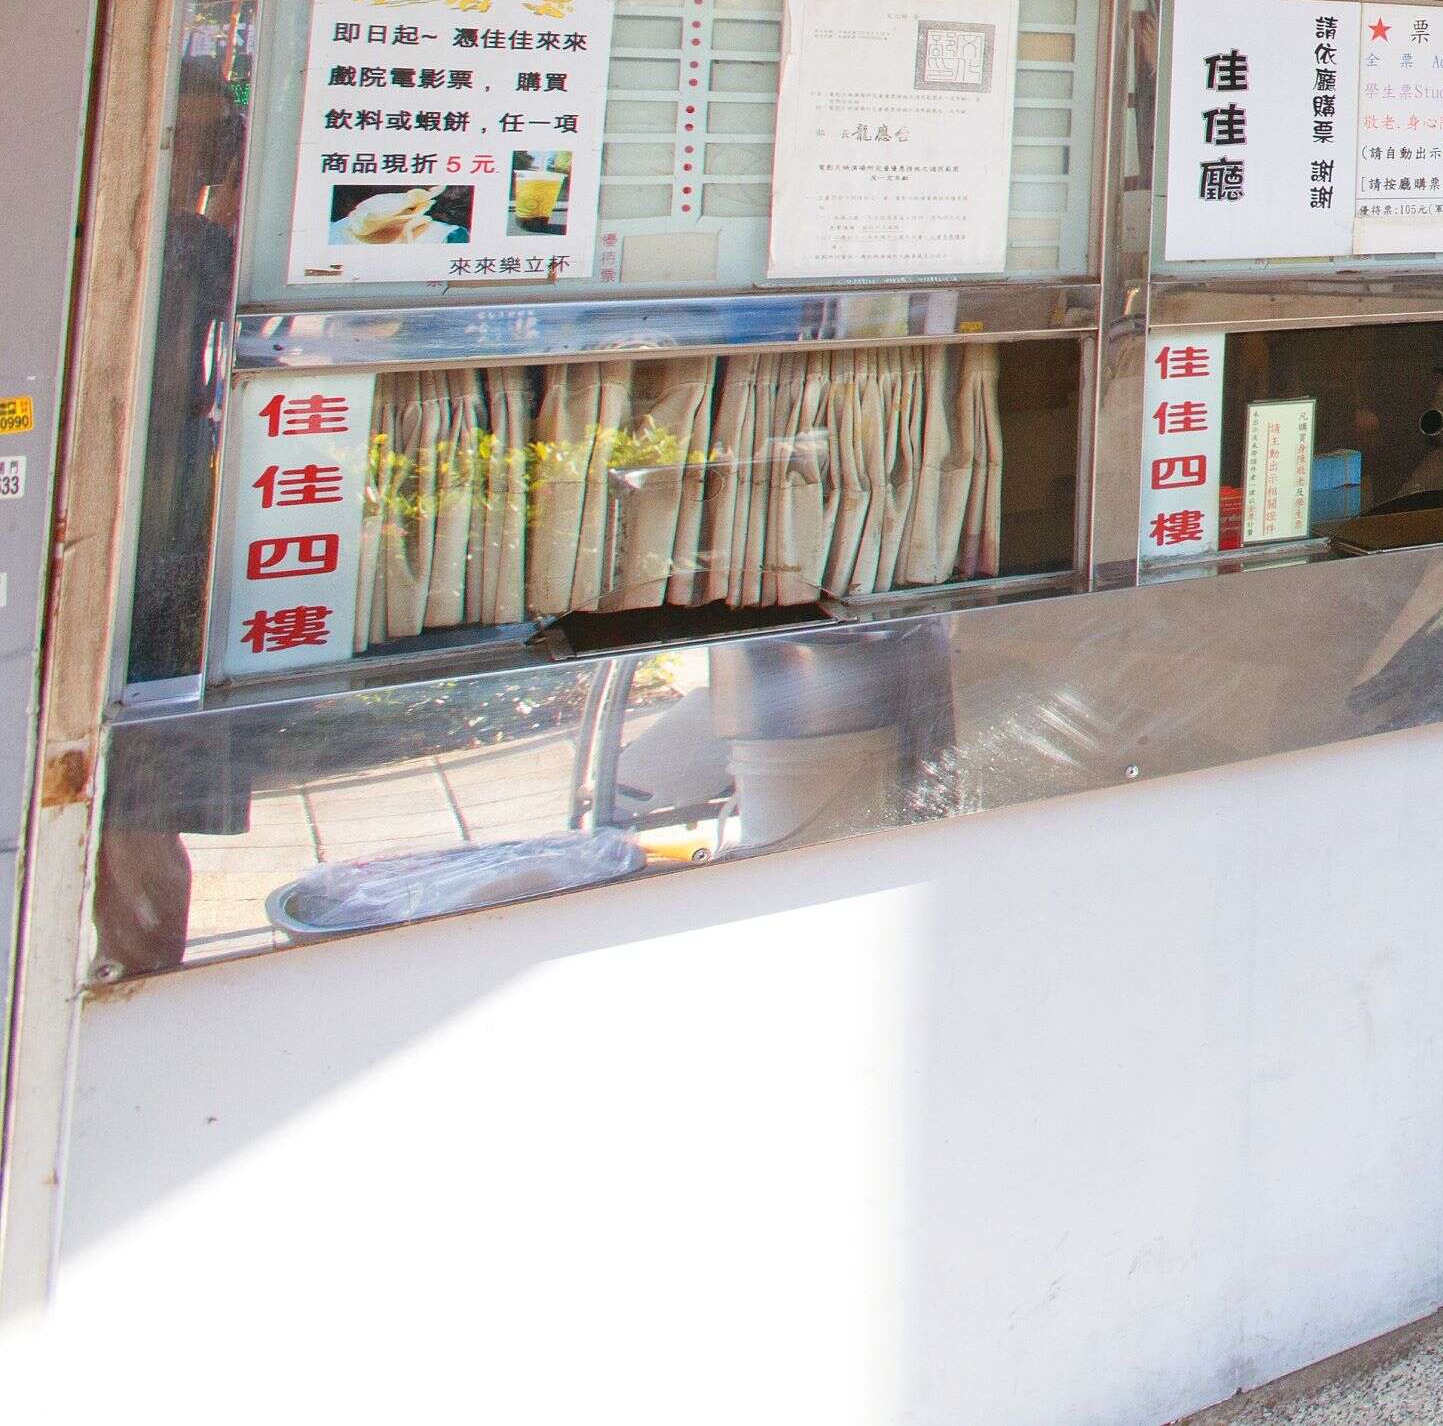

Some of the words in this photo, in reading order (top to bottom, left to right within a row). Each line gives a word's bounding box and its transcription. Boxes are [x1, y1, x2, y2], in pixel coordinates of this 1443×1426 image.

[452, 28, 588, 51] 憑佳佳來來
[515, 71, 568, 92] 購買
[1313, 16, 1339, 144] 請依廳購票
[1200, 49, 1248, 201] 佳佳廳
[1310, 160, 1334, 209] 謝謝
[450, 254, 571, 275] 來來樂立杯
[1150, 346, 1210, 545] 佳佳四樓
[241, 395, 349, 653] 佳佳四樓
